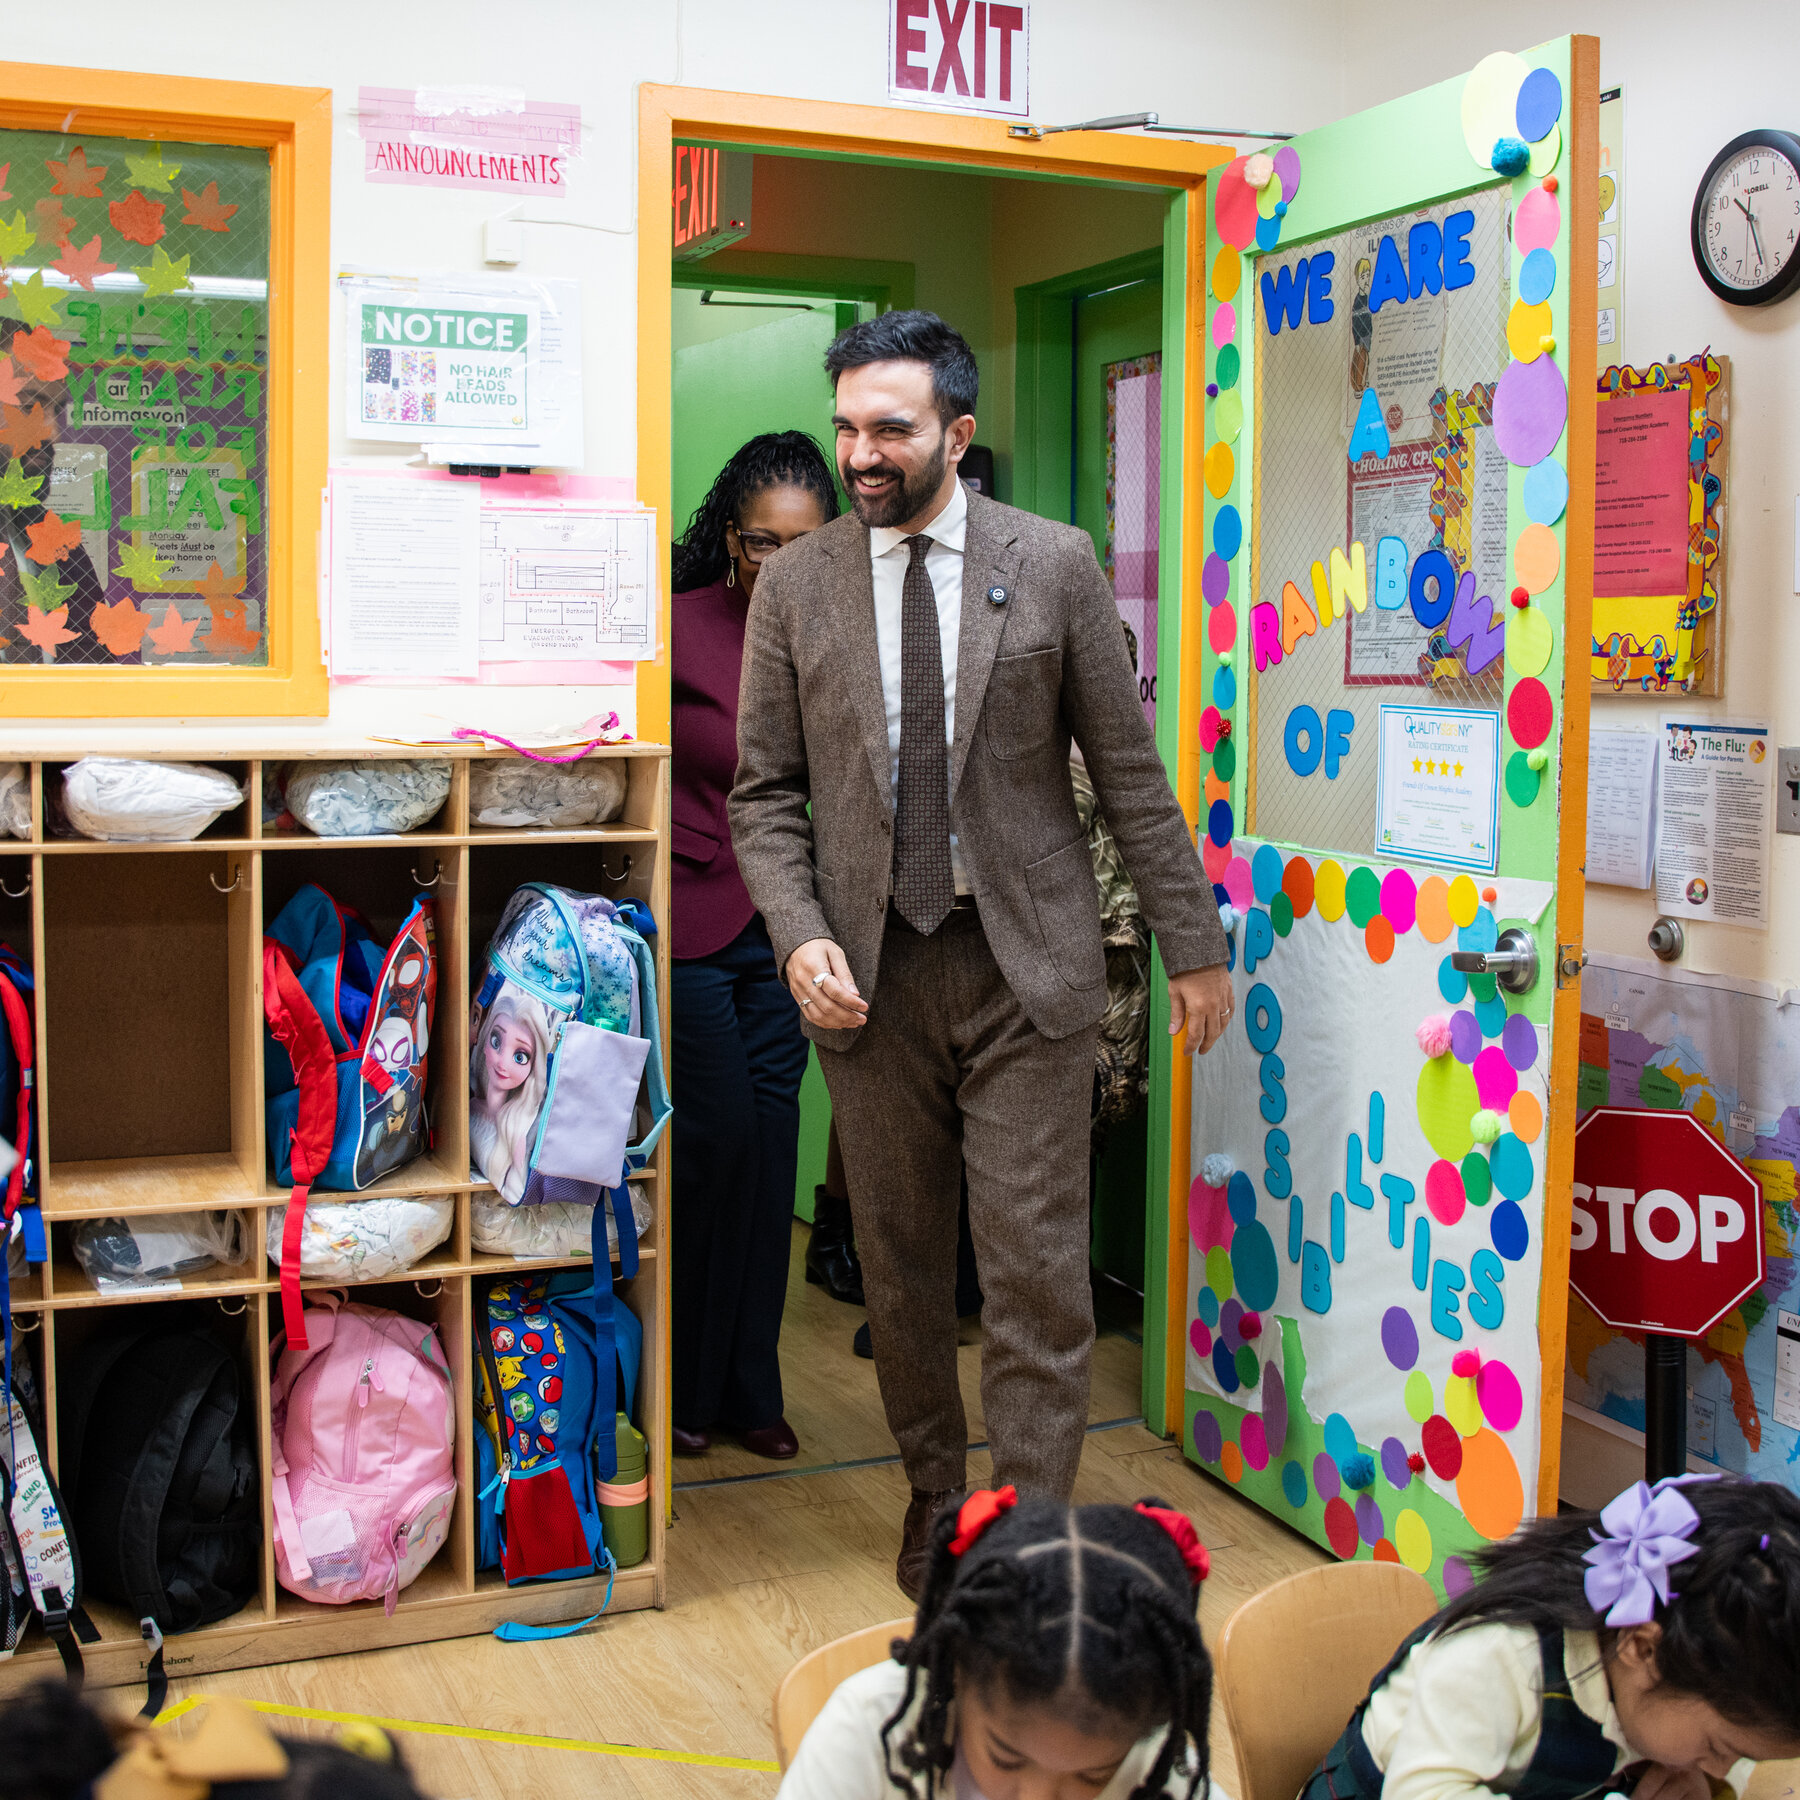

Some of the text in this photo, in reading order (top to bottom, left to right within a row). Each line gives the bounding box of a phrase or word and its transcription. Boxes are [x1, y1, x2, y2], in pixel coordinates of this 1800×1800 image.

[896, 0, 1023, 102] EXIT
[374, 142, 560, 185] ANNOUNCEMENTS
[1750, 159, 1760, 175] 12
[1772, 161, 1776, 176] 1
[1732, 173, 1740, 188] 11
[1785, 175, 1793, 191] 2
[1719, 195, 1729, 211] 10
[1793, 200, 1800, 216] 3
[1714, 221, 1721, 238] 9
[1786, 229, 1795, 243] 4
[1720, 247, 1728, 261] 8
[1774, 252, 1781, 267] 5
[1261, 210, 1476, 336] WE ARE
[1735, 259, 1743, 275] 7
[1754, 264, 1762, 278] 6
[376, 311, 514, 348] NOTICE
[449, 364, 513, 379] NO HAIR
[444, 391, 518, 406] ALLOWED
[1348, 387, 1391, 463] A
[180, 543, 201, 551] Must
[203, 542, 215, 551] be
[177, 553, 200, 561] home
[528, 606, 558, 614] Bathroom
[1250, 535, 1506, 676] RAINBOW
[1283, 704, 1355, 780] OF
[1407, 740, 1470, 754] RATING CERTIFICATE
[1700, 736, 1746, 753] The Flu:
[1726, 755, 1744, 763] Parents
[522, 930, 550, 951] your
[522, 948, 571, 983] dreams
[1244, 907, 1505, 1342] POSSIBILITIES
[1771, 1147, 1797, 1159] NEW YORK
[1569, 1182, 1746, 1264] STOP
[21, 1479, 41, 1502] KIND
